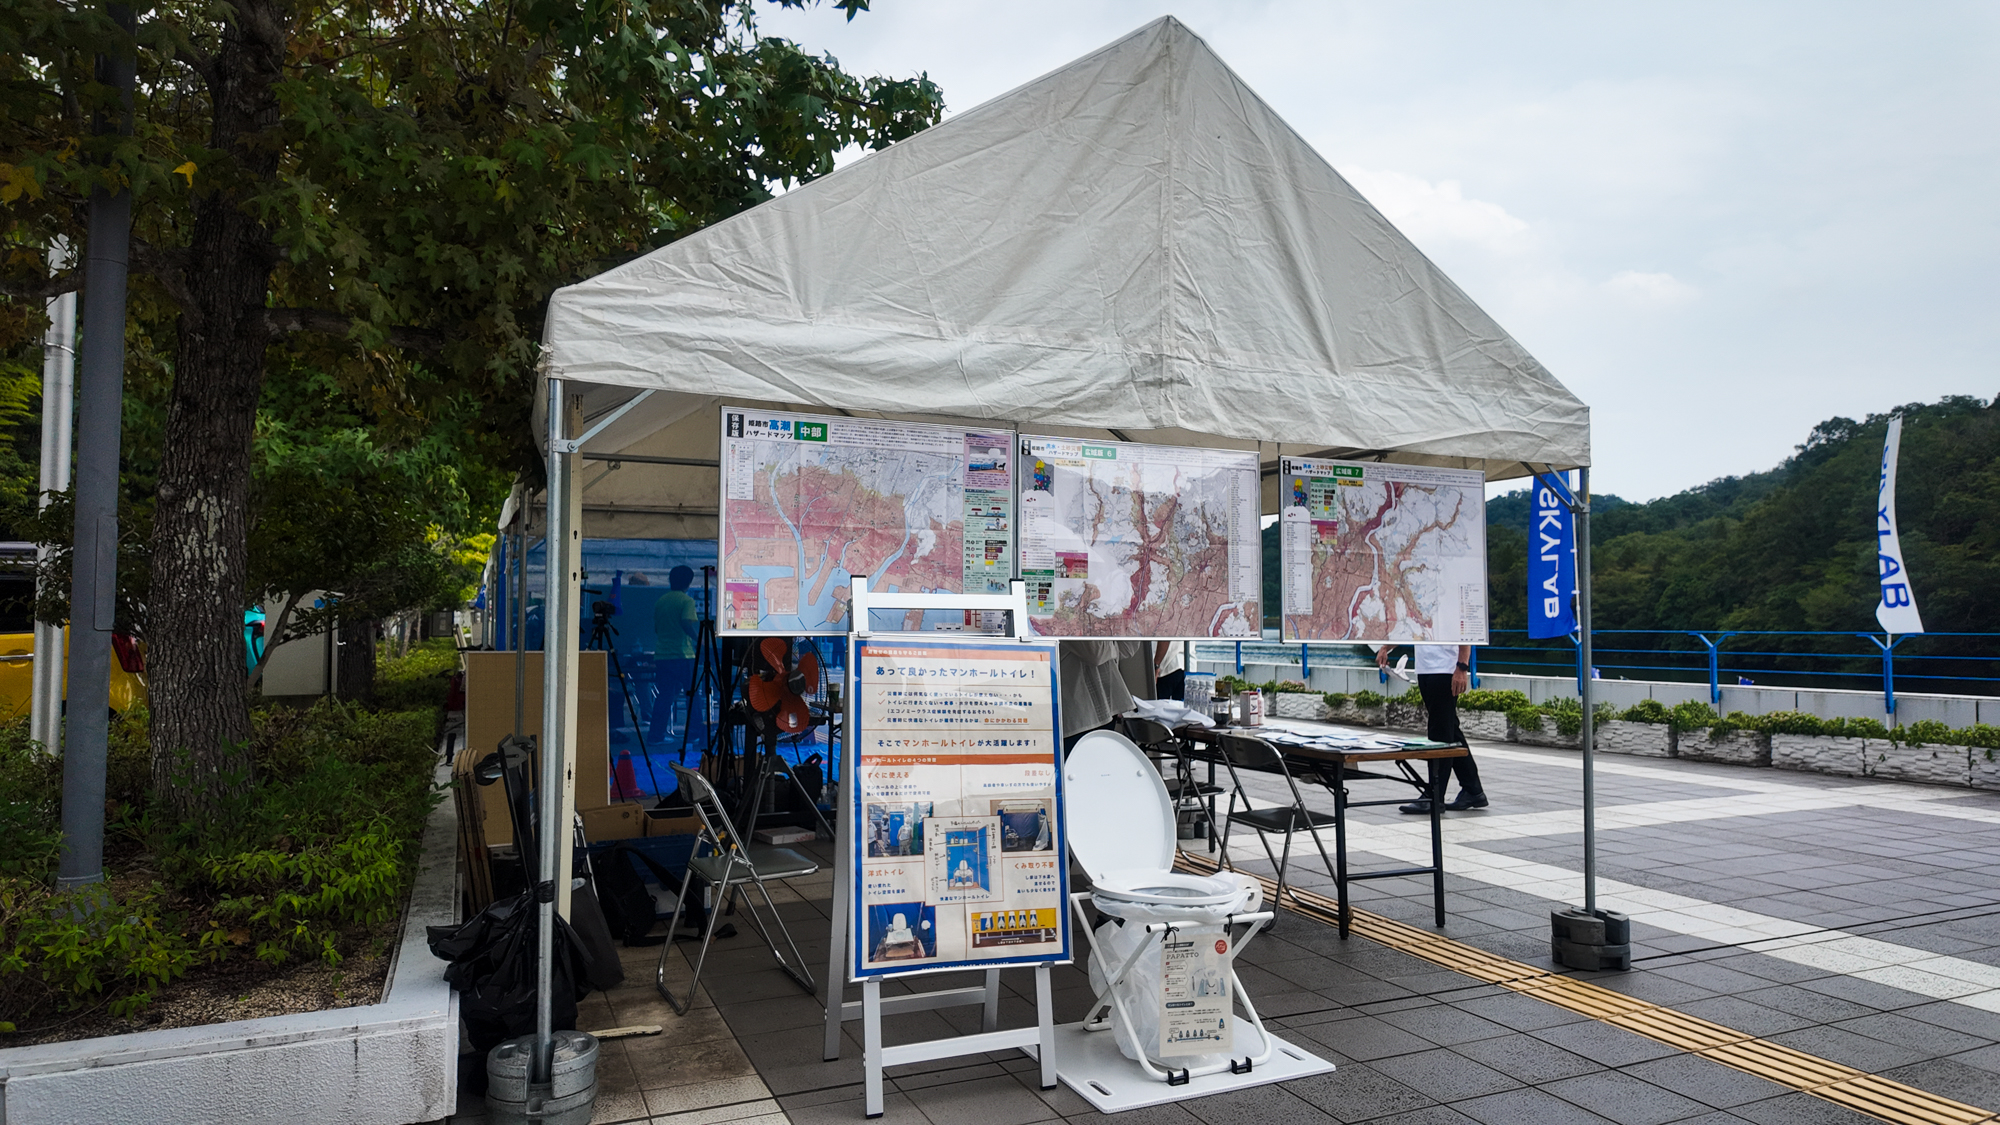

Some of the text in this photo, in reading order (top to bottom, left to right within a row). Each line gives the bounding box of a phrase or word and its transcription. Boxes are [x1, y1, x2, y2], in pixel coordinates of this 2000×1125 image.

[731, 414, 740, 438] 保存版
[745, 430, 794, 440] ハザードマップ
[800, 425, 822, 438] 中部
[876, 666, 1035, 678] あって良かったマンホールトイレ！
[877, 739, 1036, 748] そこでマンホールトイレが大活躍します！
[867, 771, 910, 779] すぐに使える
[1024, 769, 1051, 777] 段差なし
[1014, 861, 1055, 869] くみ取り不要
[867, 868, 905, 877] 洋式トイレ
[1166, 951, 1200, 960] PAPATTO
